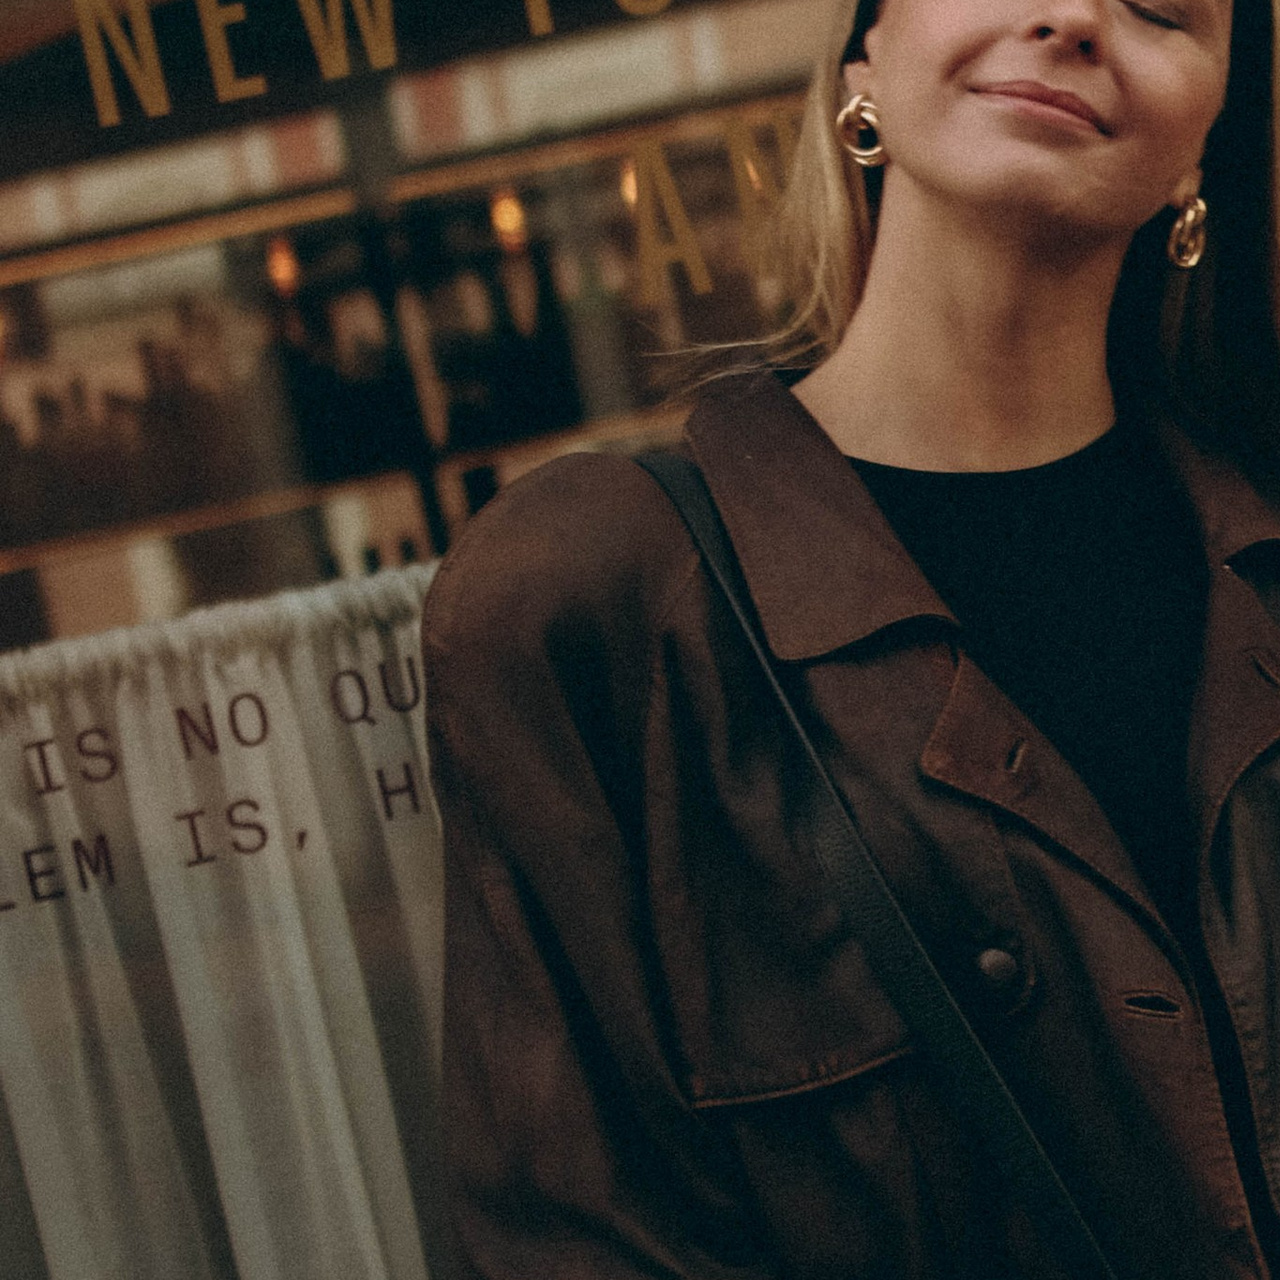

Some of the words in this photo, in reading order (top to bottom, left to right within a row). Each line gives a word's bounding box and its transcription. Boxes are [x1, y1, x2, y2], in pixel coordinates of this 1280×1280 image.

[24, 726, 119, 796] IS
[176, 692, 270, 761] NO
[0, 833, 116, 912] EM
[175, 798, 309, 869] IS,
